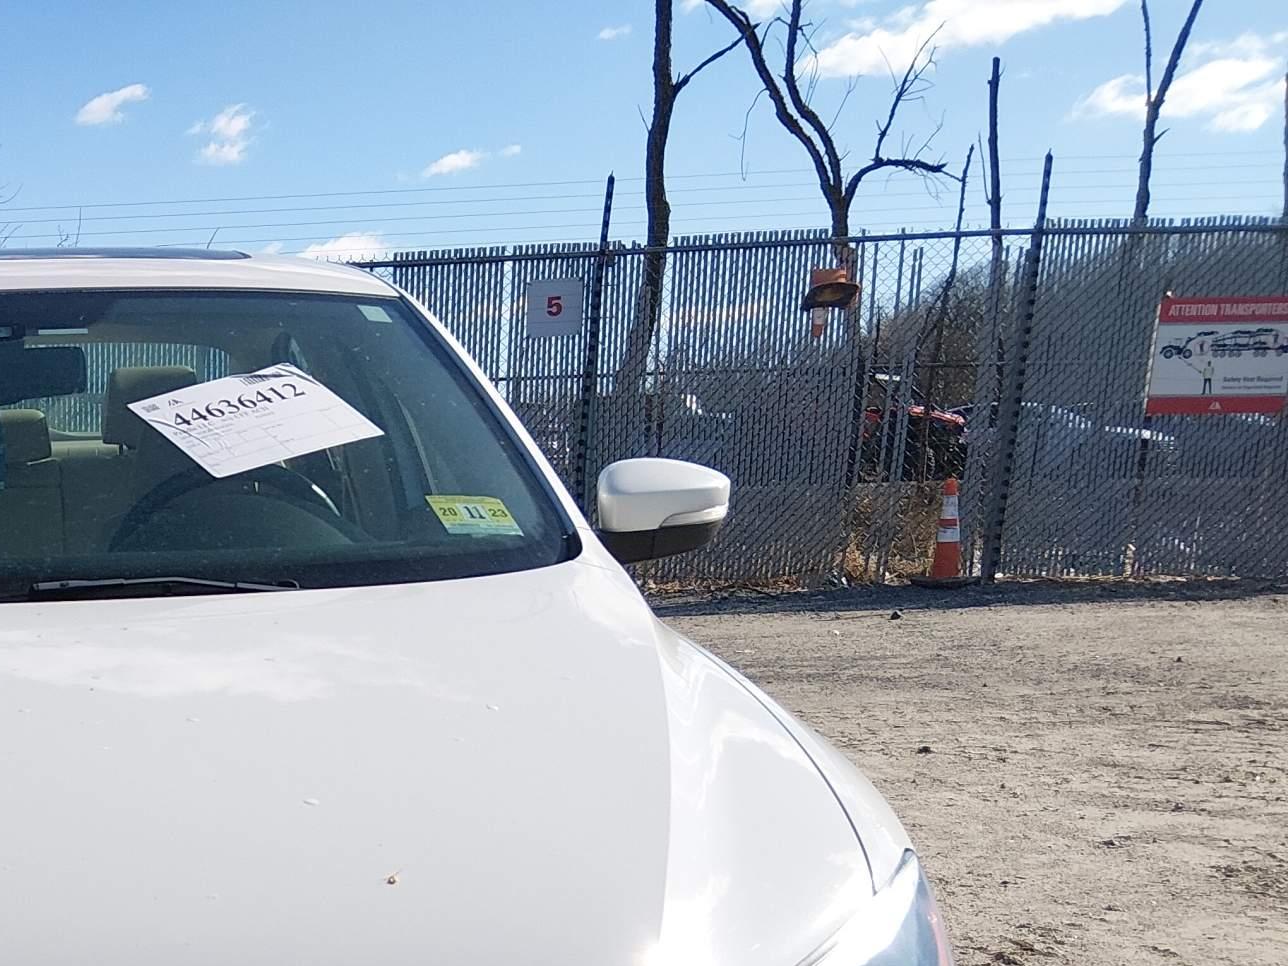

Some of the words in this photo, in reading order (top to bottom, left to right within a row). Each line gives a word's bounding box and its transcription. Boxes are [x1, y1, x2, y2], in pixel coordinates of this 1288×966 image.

[546, 296, 563, 317] 5
[1168, 304, 1218, 317] ATTENTION
[1220, 302, 1288, 316] TRANSPORTERS
[174, 382, 306, 426] 44636412
[439, 507, 458, 517] 20
[463, 505, 486, 520] 11
[488, 508, 508, 518] 23
